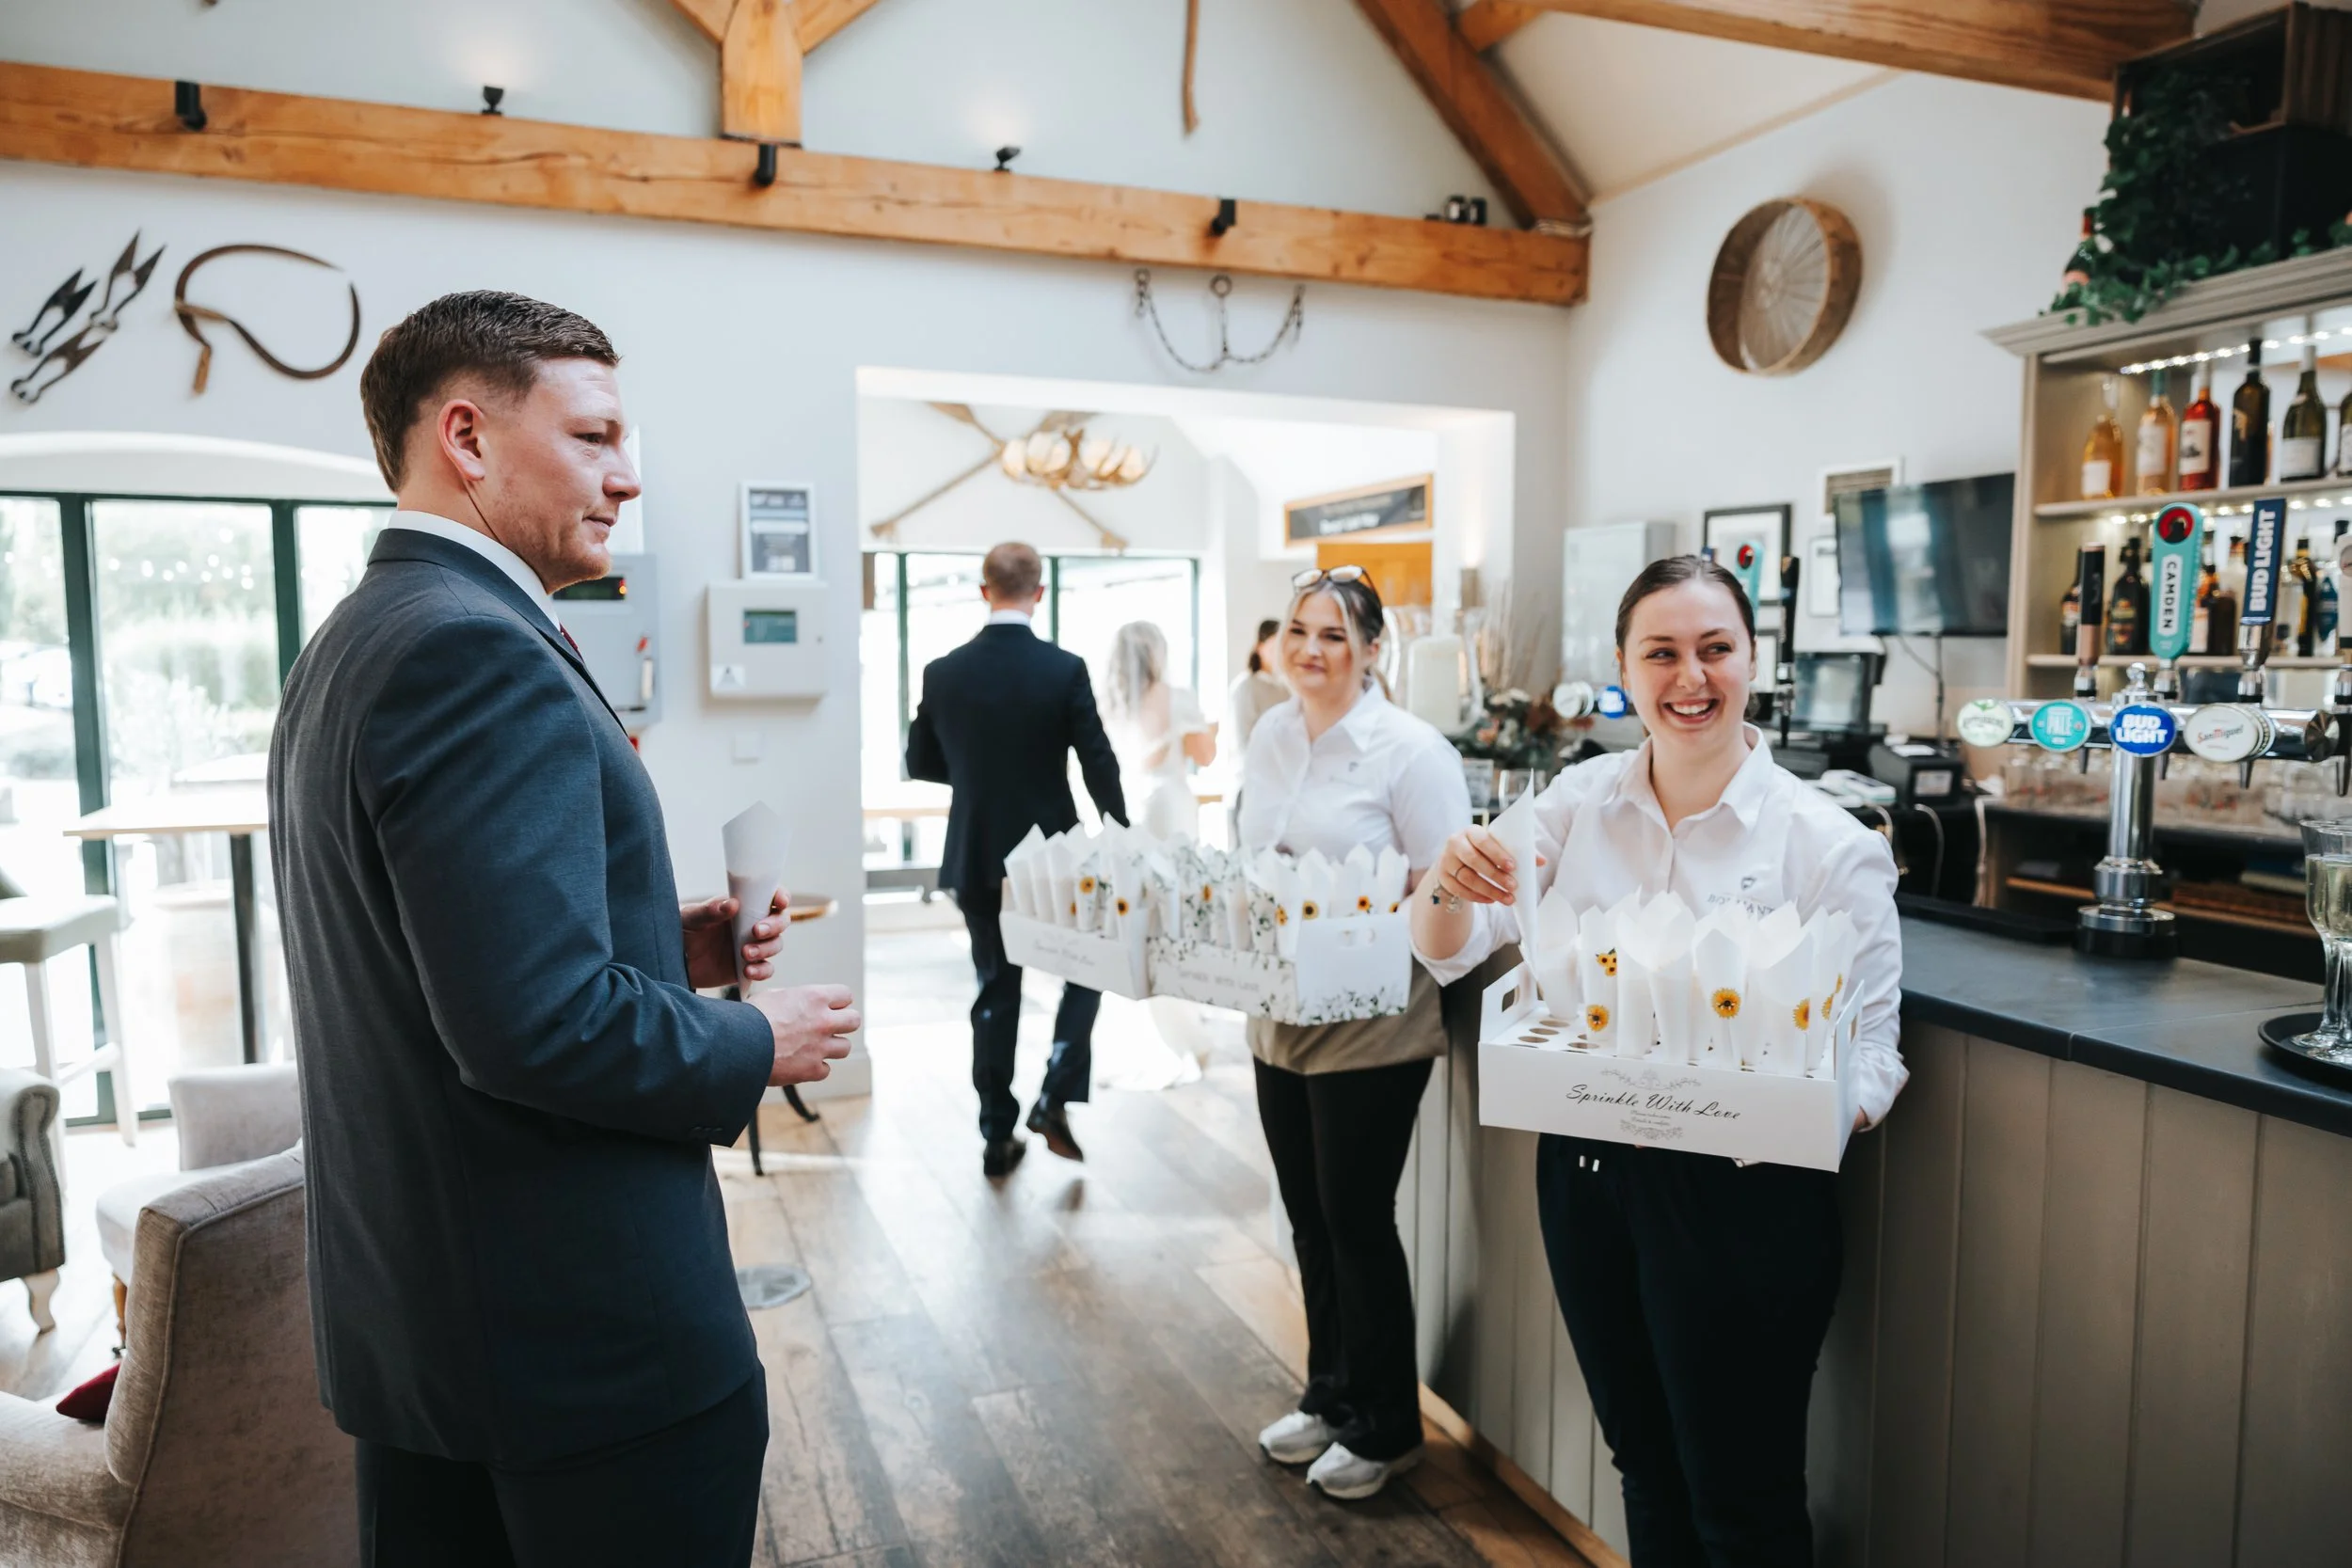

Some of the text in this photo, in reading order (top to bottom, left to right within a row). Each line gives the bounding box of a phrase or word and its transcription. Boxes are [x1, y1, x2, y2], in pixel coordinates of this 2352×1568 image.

[2249, 509, 2276, 611] BUD LIGHT
[2163, 562, 2177, 628] CAMDEN
[2115, 727, 2168, 743] LIGHT
[2122, 714, 2161, 729] BUD
[1565, 1084, 1639, 1107] Sprinkle
[1645, 1093, 1693, 1114] With
[1693, 1101, 1740, 1119] Love
